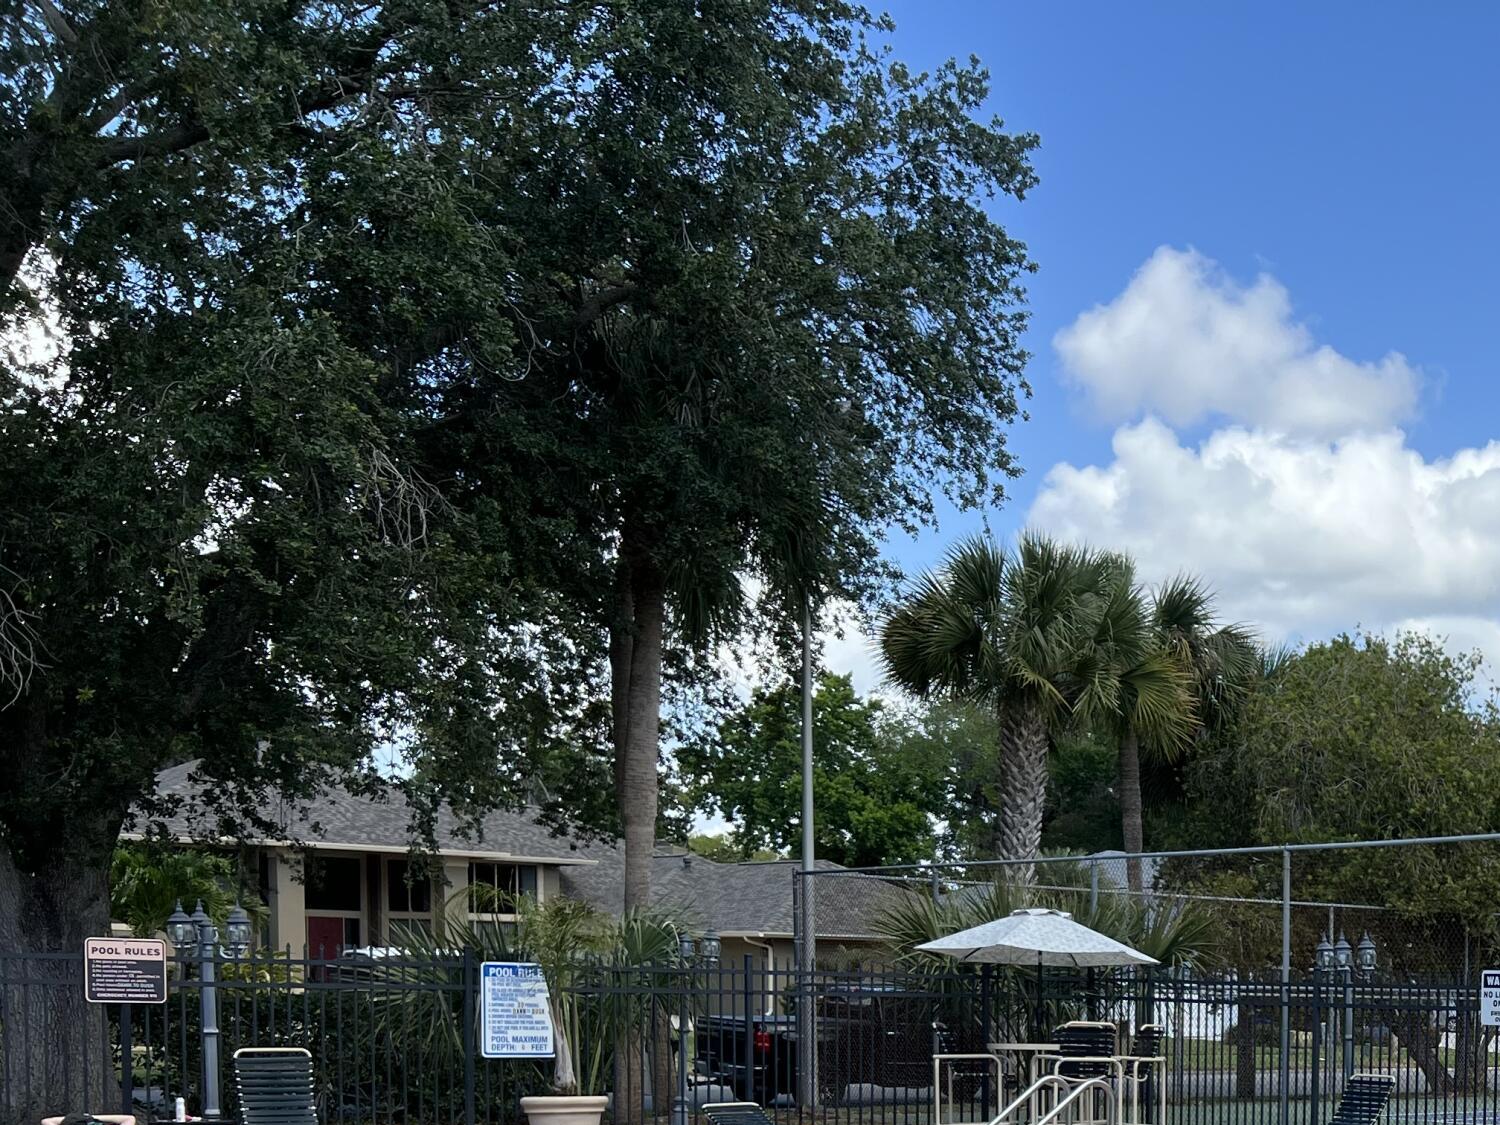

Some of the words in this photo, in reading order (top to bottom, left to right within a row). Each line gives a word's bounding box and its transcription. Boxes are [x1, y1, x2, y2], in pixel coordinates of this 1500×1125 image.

[91, 946, 121, 955] POOL
[125, 948, 161, 956] RULES
[489, 967, 515, 977] POOL
[518, 967, 543, 977] RULE
